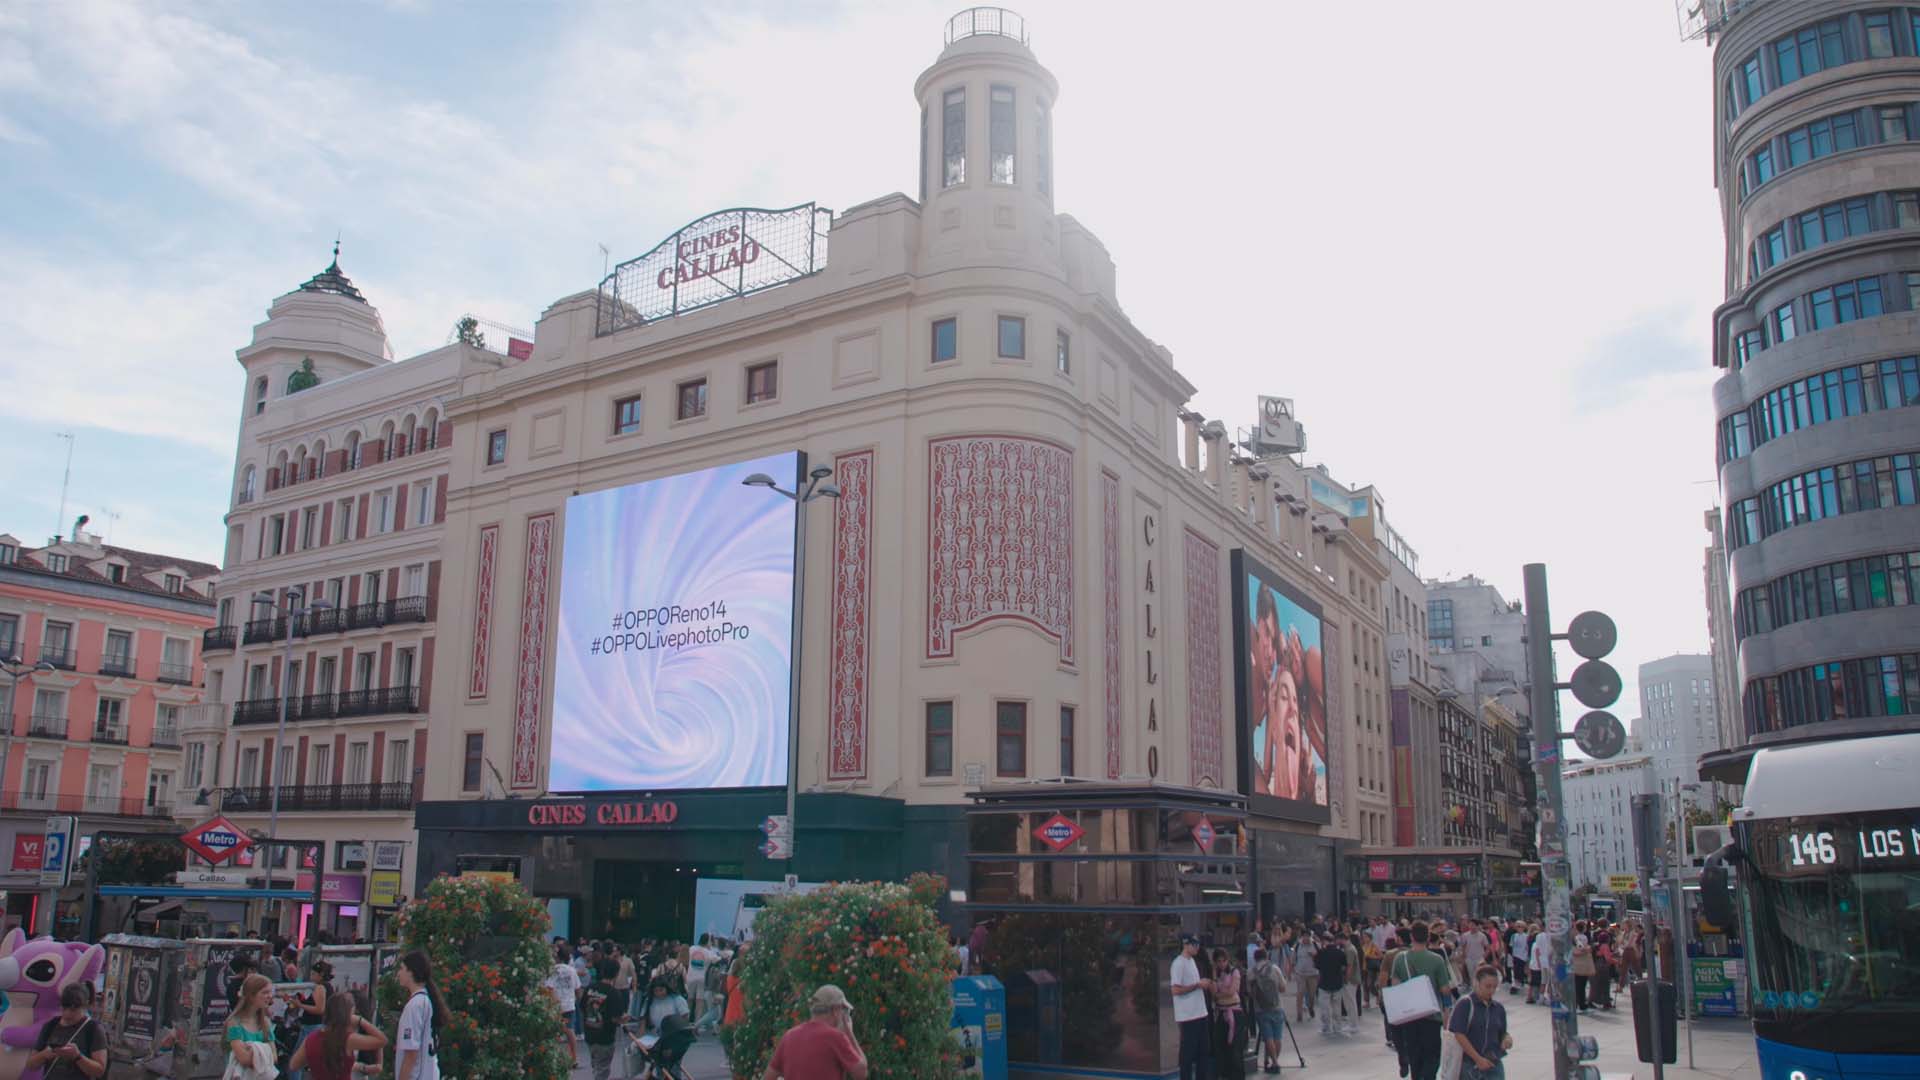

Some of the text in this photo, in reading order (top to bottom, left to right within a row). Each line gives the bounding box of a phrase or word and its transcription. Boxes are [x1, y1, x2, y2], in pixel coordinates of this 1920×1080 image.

[678, 224, 740, 261] CINES
[657, 241, 760, 290] CALLAO
[612, 599, 727, 631] #OPPOReno14
[591, 622, 750, 656] #OPPOLivephotoPro
[1144, 514, 1158, 779] CALLAO
[528, 801, 678, 825] CINES CALLAO
[204, 832, 235, 845] Metro
[1047, 828, 1070, 837] Metro
[1789, 831, 1837, 866] 146
[1859, 828, 1904, 859] LOS
[199, 874, 226, 882] Callao
